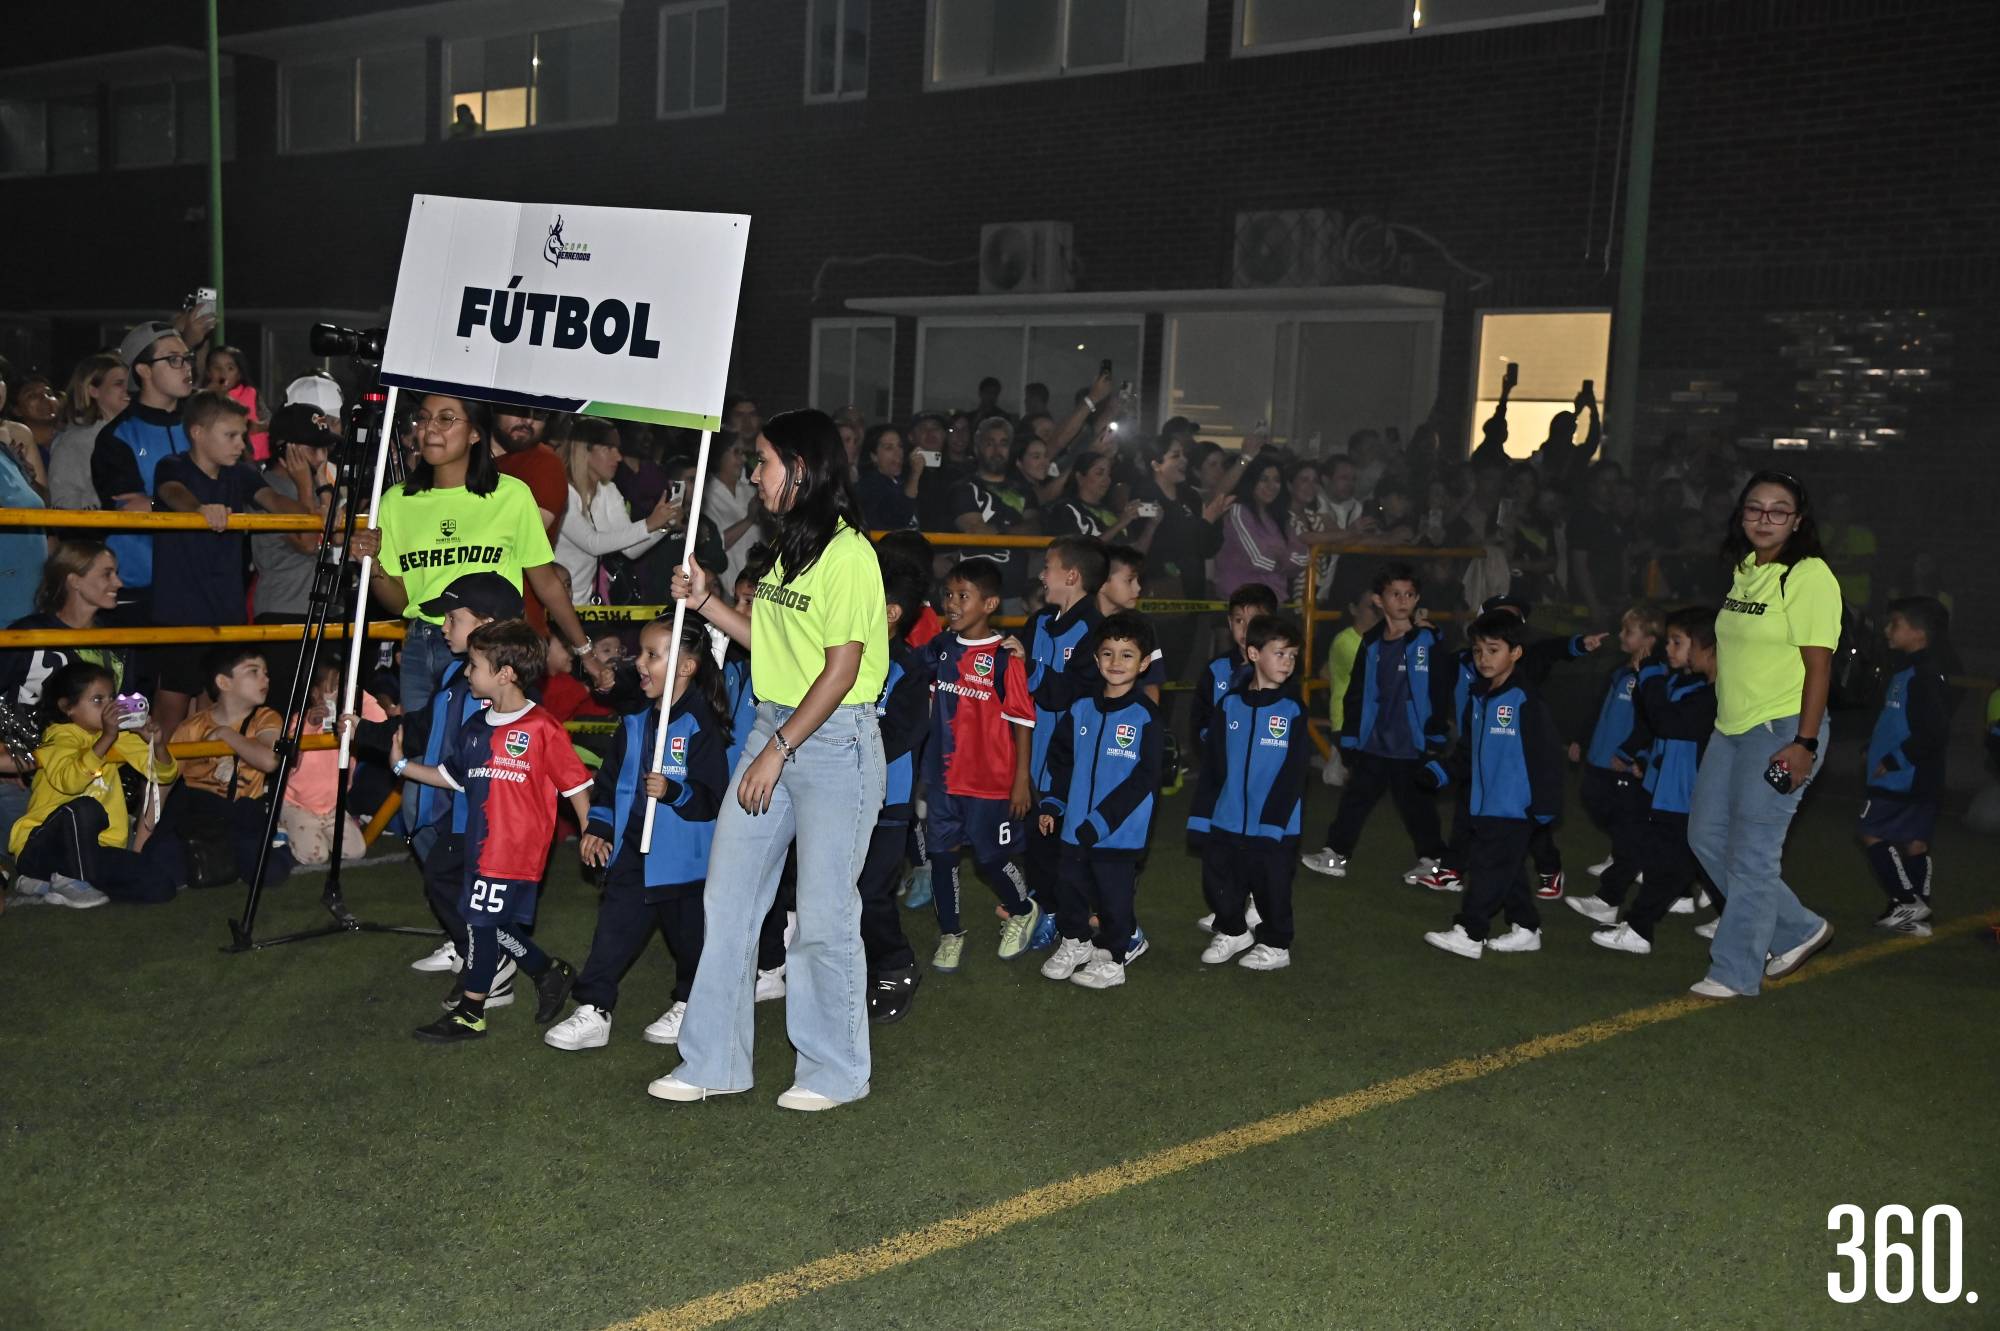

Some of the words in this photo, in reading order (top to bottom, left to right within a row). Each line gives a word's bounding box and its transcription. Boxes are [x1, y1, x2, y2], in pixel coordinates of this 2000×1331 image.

[564, 242, 588, 251] COPA
[457, 275, 660, 359] FÚTBOL
[399, 545, 503, 572] BERRENDOS
[998, 821, 1011, 845] 6
[469, 879, 508, 913] 25
